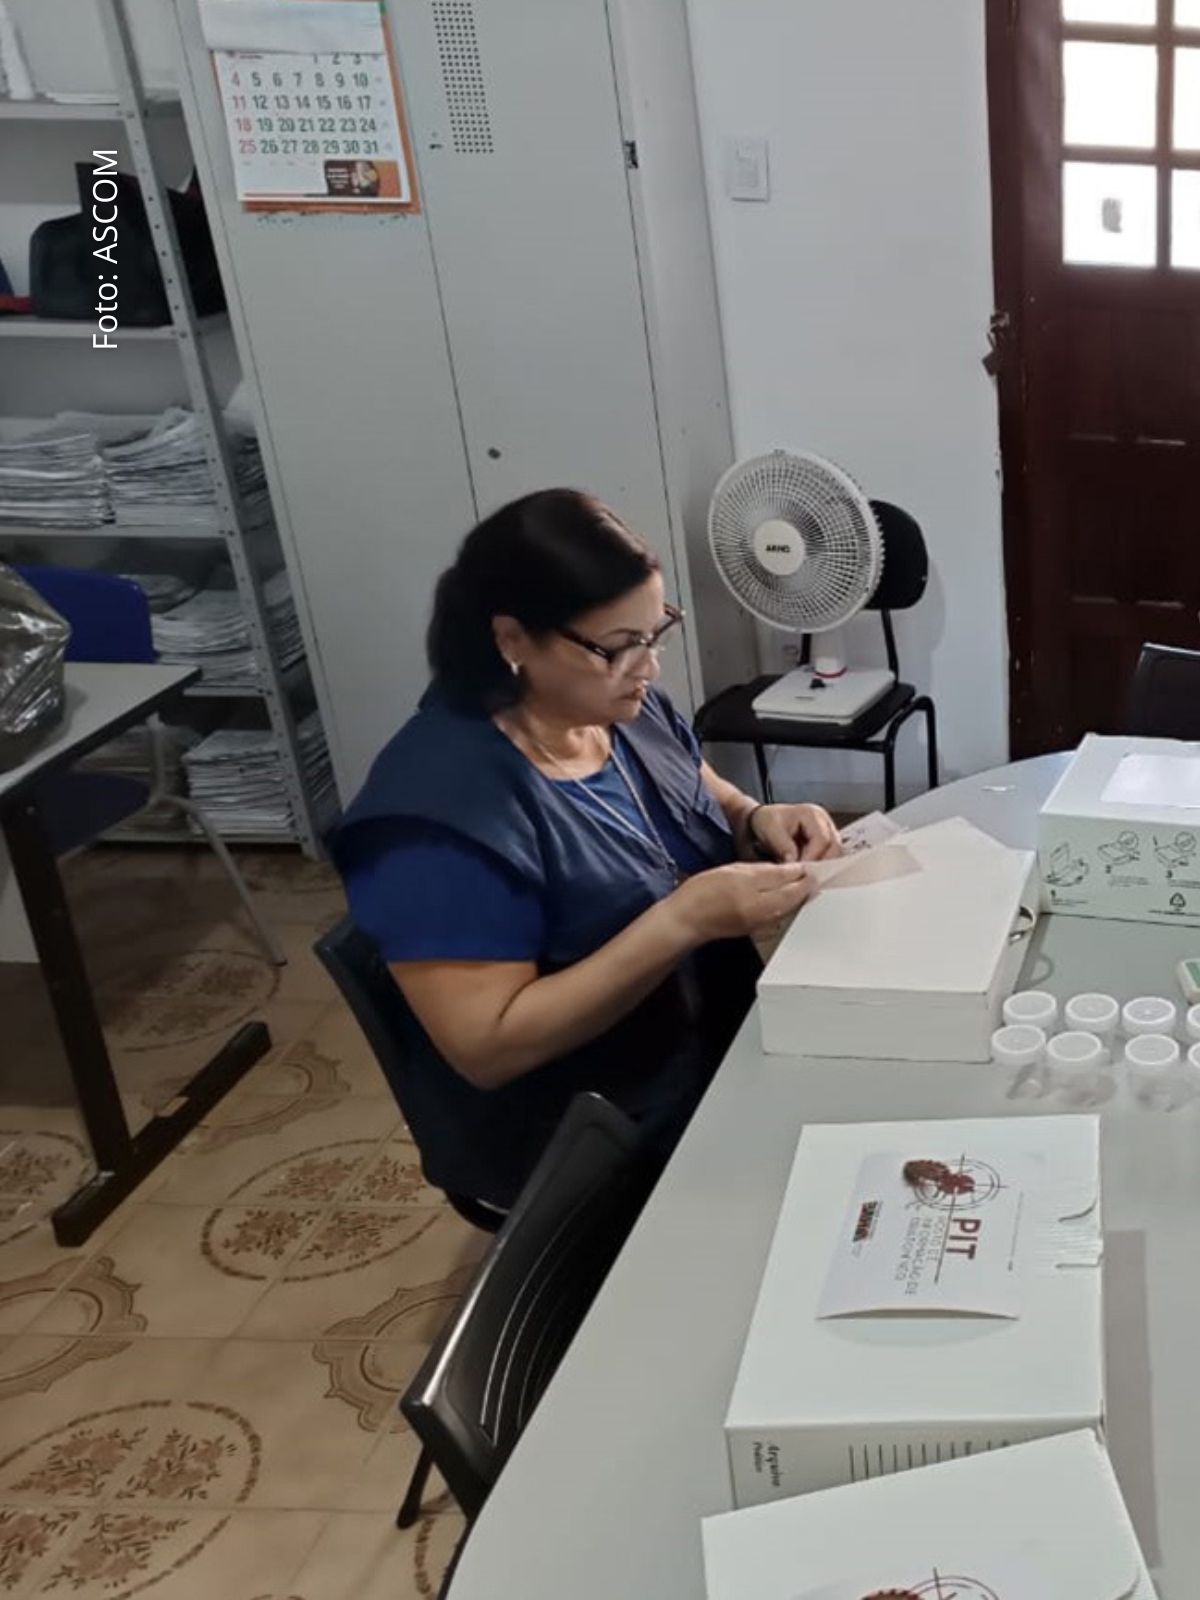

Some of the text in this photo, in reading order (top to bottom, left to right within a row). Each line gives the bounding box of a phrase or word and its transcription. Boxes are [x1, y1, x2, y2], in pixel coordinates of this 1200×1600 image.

[332, 54, 341, 64] 2
[232, 72, 368, 87] 4 5 6 7 8 9 10
[233, 95, 371, 110] 11 12 13 14 15 16 17
[235, 118, 377, 132] 18 19 20 21 22 23 24
[239, 140, 379, 154] 25 26 27 28 29 30 31
[946, 1218, 981, 1259] PIT
